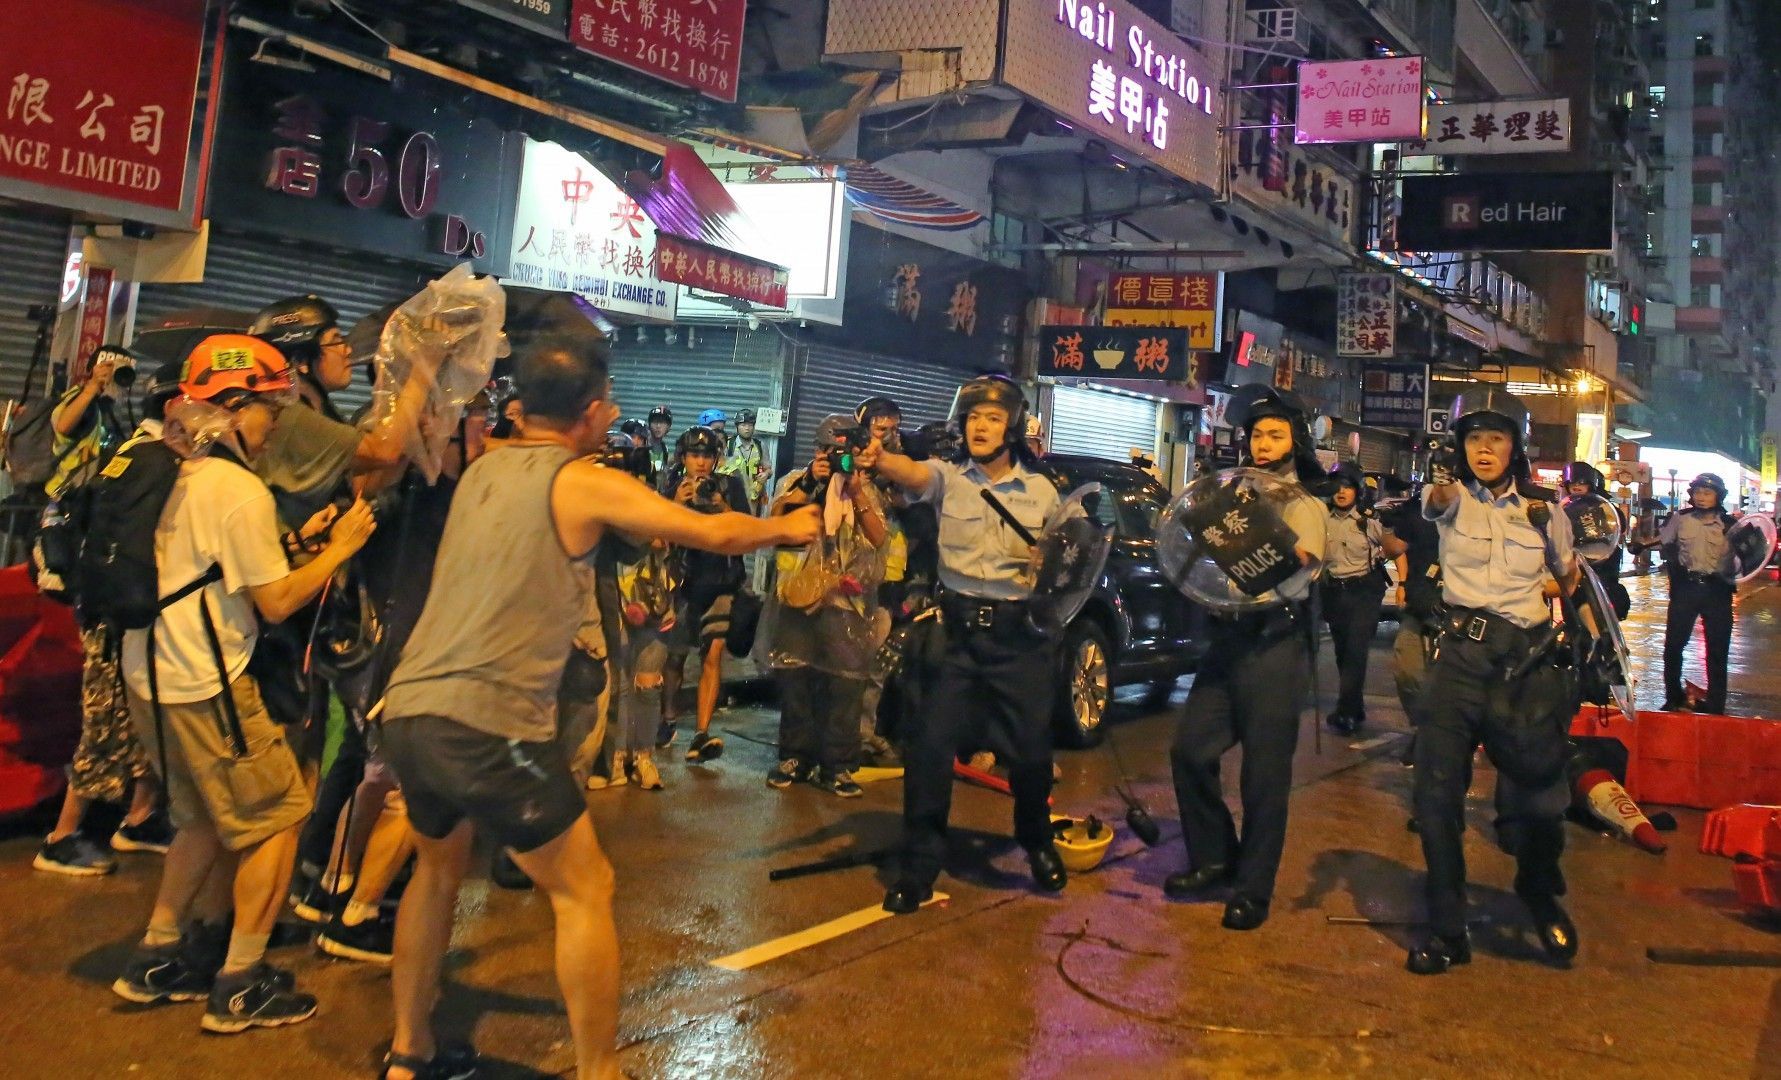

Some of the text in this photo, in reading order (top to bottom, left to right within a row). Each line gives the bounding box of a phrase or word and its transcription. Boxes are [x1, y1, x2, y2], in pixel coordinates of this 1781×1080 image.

[512, 0, 551, 15] 1959
[1056, 0, 1116, 52] Nail
[595, 0, 732, 61] 民幣找換行
[635, 37, 680, 72] 2612
[688, 58, 728, 91] 1878
[1088, 58, 1169, 150] 美甲站
[1316, 77, 1419, 99] Nail Station
[8, 72, 165, 156] 限公司
[1323, 107, 1391, 129] 美甲站
[59, 147, 161, 192] LIMITED
[1517, 201, 1567, 222] Hair
[611, 280, 653, 305] EXCHANGE
[655, 289, 668, 308] CO.
[1228, 542, 1284, 583] POLICE
